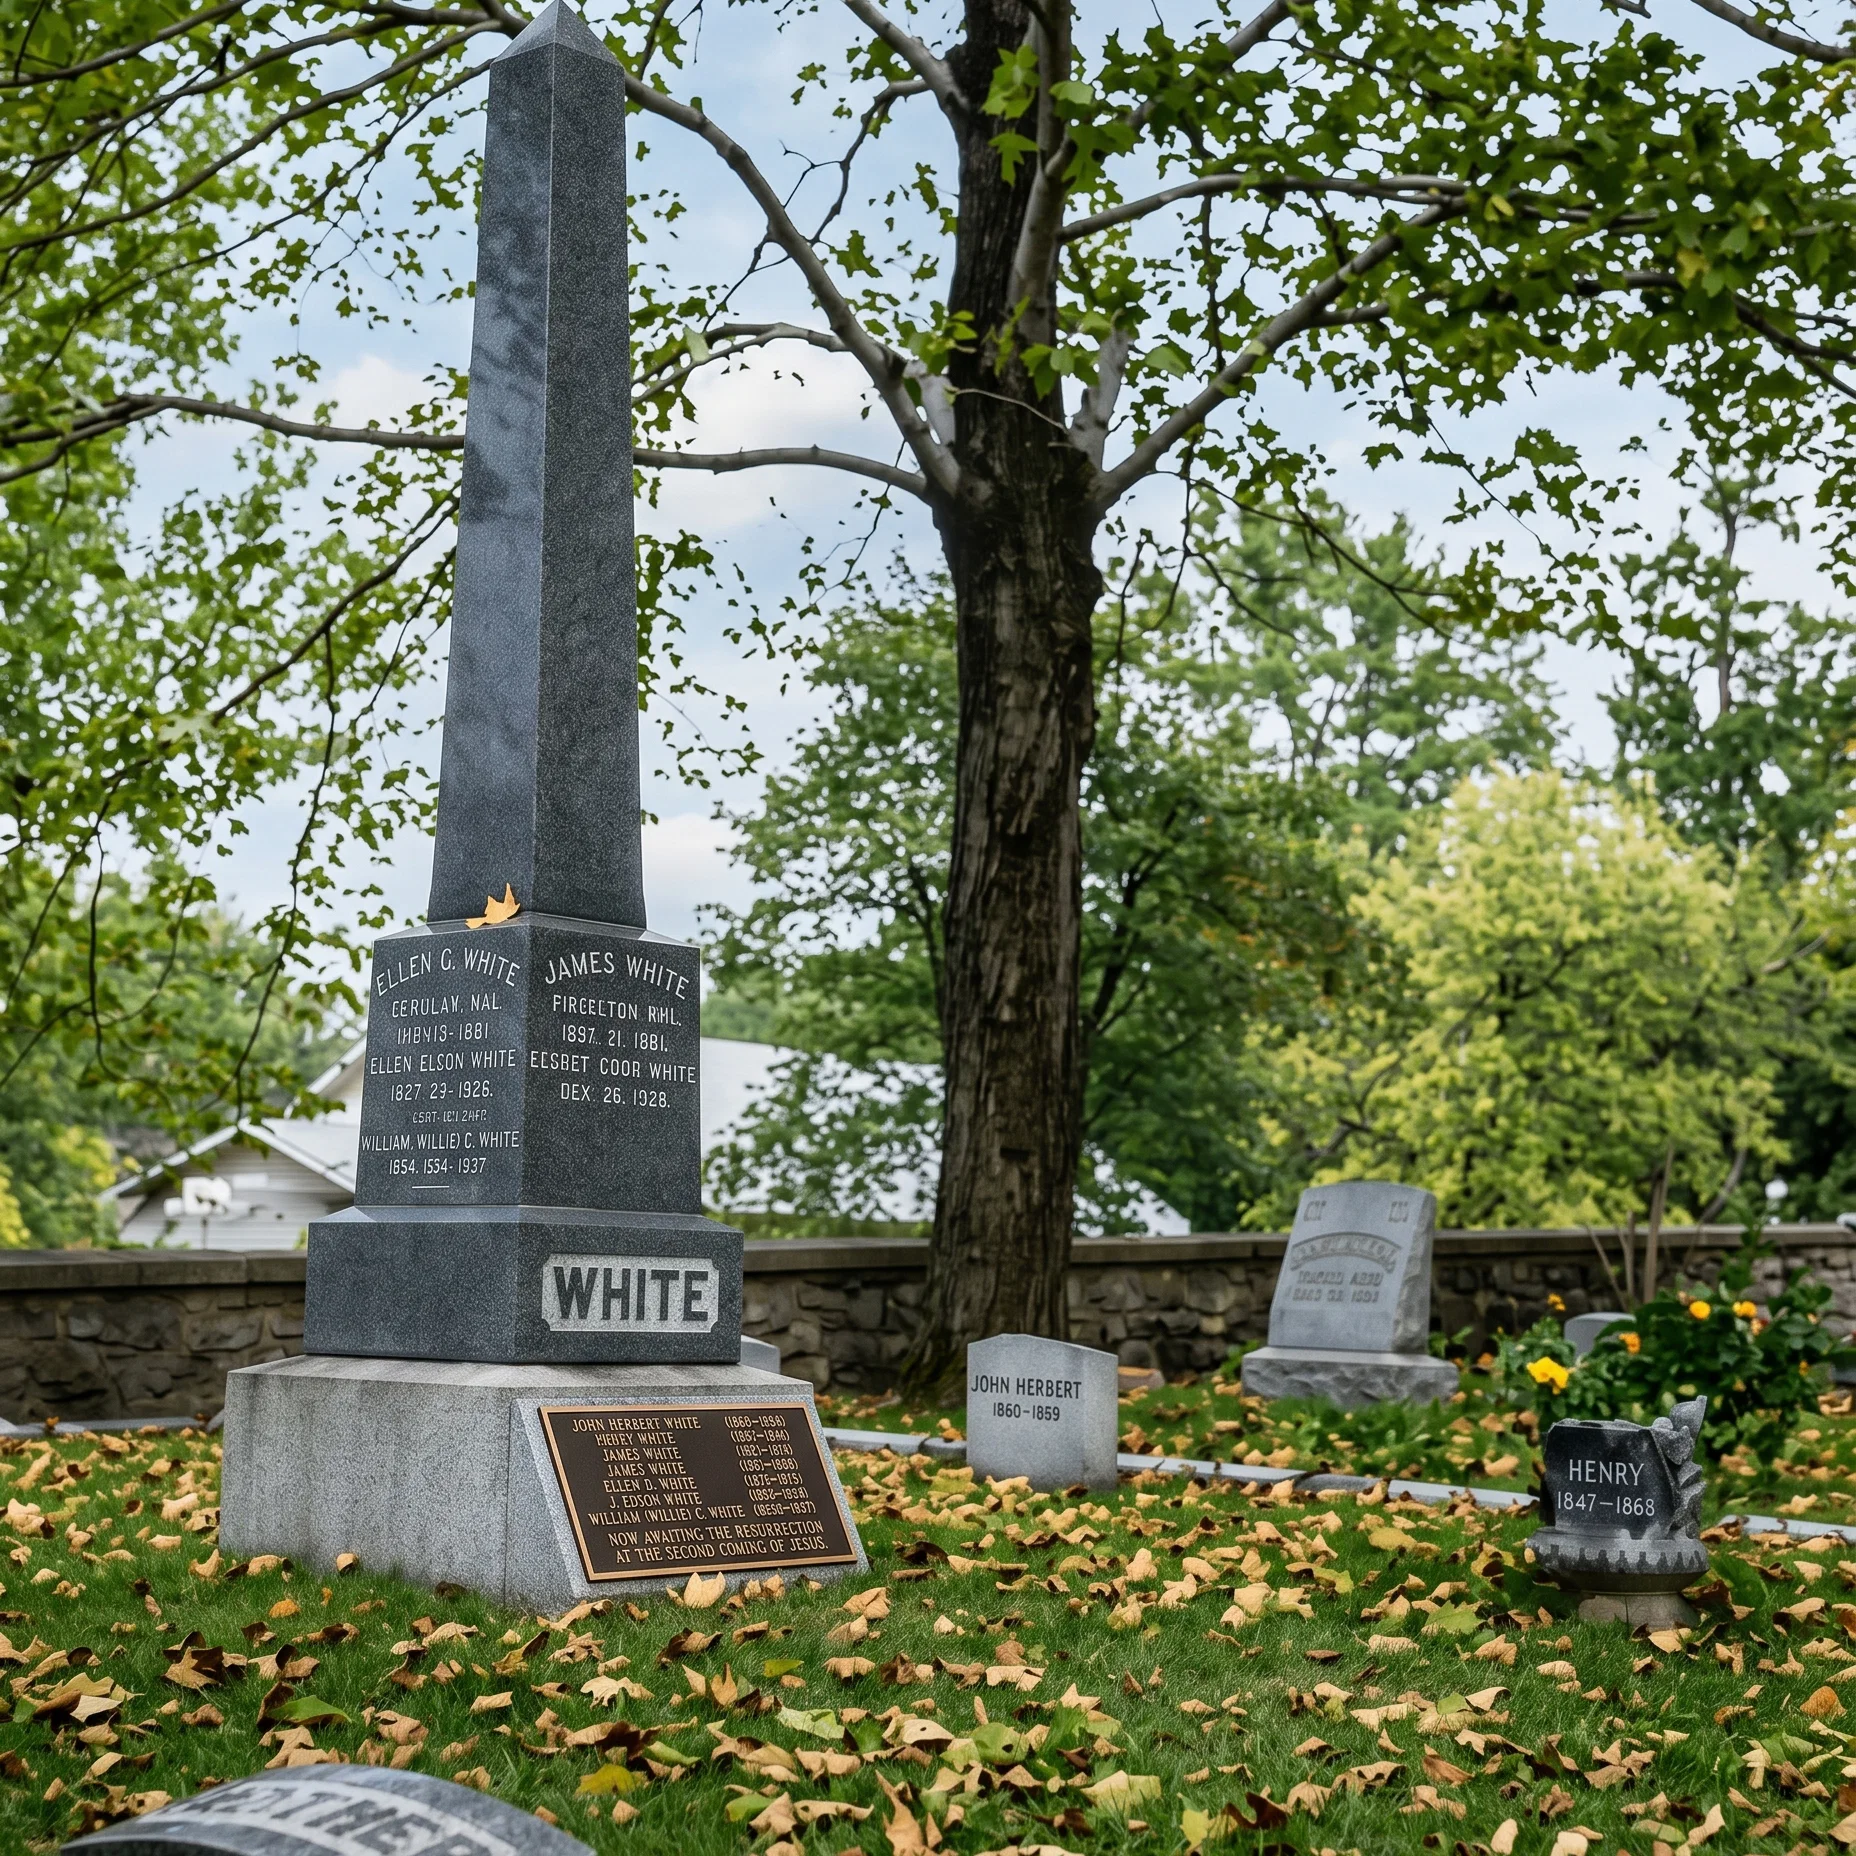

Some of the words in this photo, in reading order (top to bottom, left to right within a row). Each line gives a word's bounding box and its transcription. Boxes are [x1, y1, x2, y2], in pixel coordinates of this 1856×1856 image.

[376, 951, 431, 997] ELLEN
[464, 947, 520, 986] WHITE
[545, 951, 615, 985] JAMES
[626, 954, 690, 1000] WHITE
[370, 1055, 412, 1074] ELLEN
[420, 1052, 464, 1072] ELSON
[471, 1049, 516, 1069] WHITE
[649, 1062, 696, 1083] WHITE
[603, 1086, 626, 1105] 26.
[417, 1132, 461, 1150] WILLIE)
[464, 1131, 475, 1149] C.
[479, 1131, 520, 1148] WHITE
[458, 1157, 487, 1174] 1937
[553, 1266, 709, 1322] WHITE
[971, 1375, 1010, 1394] JOHN
[1016, 1377, 1082, 1399] HERBERT
[993, 1402, 1060, 1422] 1860-1859
[572, 1419, 605, 1432] JOHN
[608, 1417, 661, 1431] HERBERT
[663, 1416, 701, 1430] WHITE
[637, 1432, 676, 1445] WHITE
[603, 1448, 640, 1462] JAMES
[643, 1447, 682, 1460] WHITE
[607, 1463, 645, 1477] JAMES
[648, 1462, 686, 1475] WHITE
[1569, 1459, 1645, 1486] HENRY
[603, 1479, 641, 1493] ELLEN
[659, 1477, 698, 1490] WHITE
[609, 1495, 620, 1509] J.
[621, 1494, 662, 1508] EDSON
[663, 1492, 703, 1506] WHITE
[1557, 1491, 1655, 1517] 1847-1868
[588, 1510, 641, 1526] WILLIAM
[644, 1507, 692, 1523] (WILLIE)
[695, 1507, 707, 1520] C.
[708, 1505, 746, 1519] WHITE
[608, 1531, 638, 1547] NOW
[644, 1527, 704, 1544] AWAITING
[705, 1526, 733, 1540] THE
[736, 1520, 824, 1538] RESURRECTION
[616, 1549, 631, 1564] AT
[634, 1547, 663, 1562] THE
[666, 1543, 715, 1560] SECOND
[719, 1540, 767, 1556] COMING
[769, 1538, 785, 1553] OF
[790, 1536, 829, 1551] JESUS.
